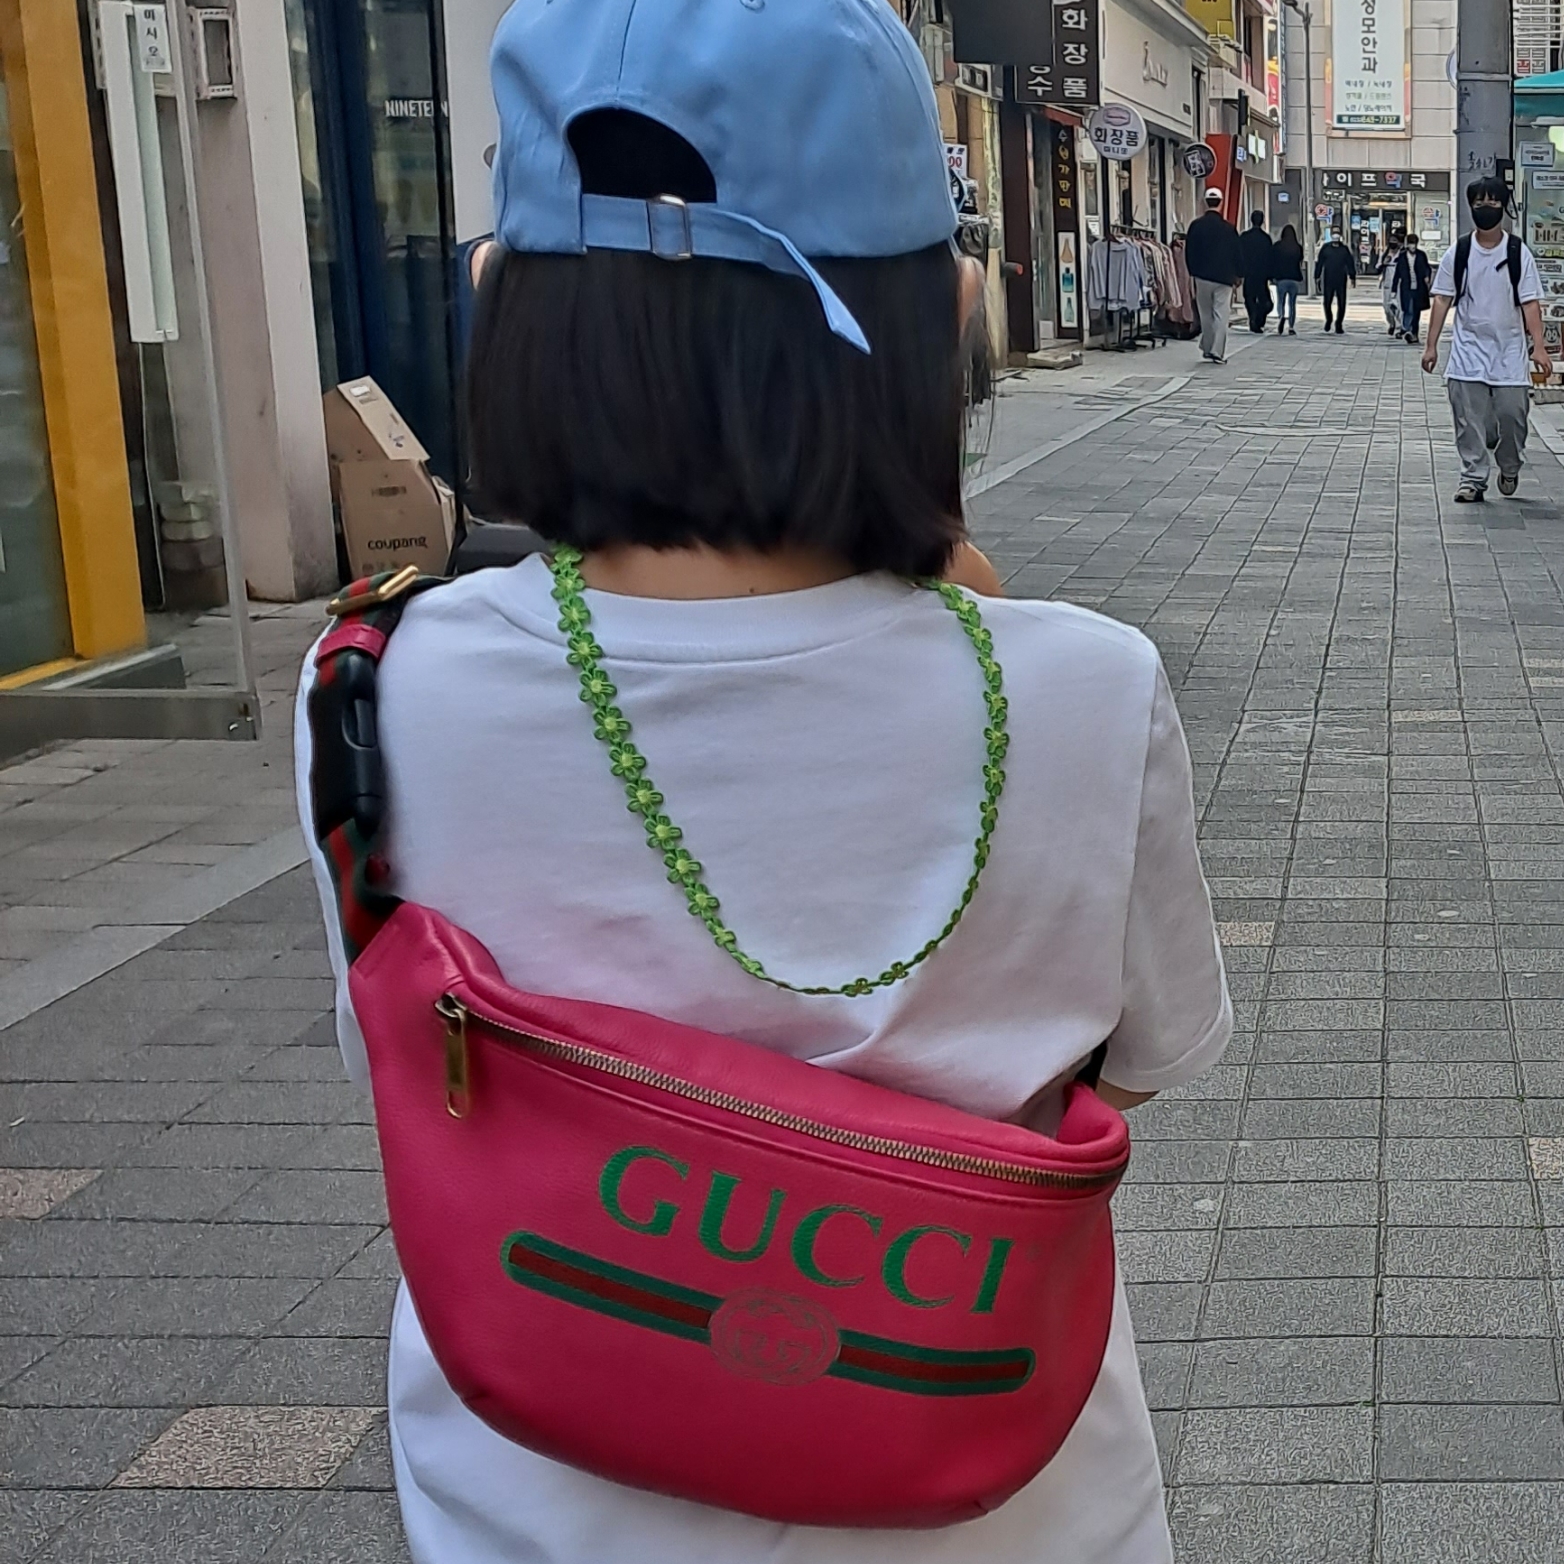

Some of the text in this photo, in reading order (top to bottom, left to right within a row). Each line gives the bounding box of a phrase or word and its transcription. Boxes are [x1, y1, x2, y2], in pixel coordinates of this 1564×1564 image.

[1061, 8, 1088, 98] 화장품
[367, 536, 428, 551] coupang
[599, 1144, 1016, 1315] GUCCI
